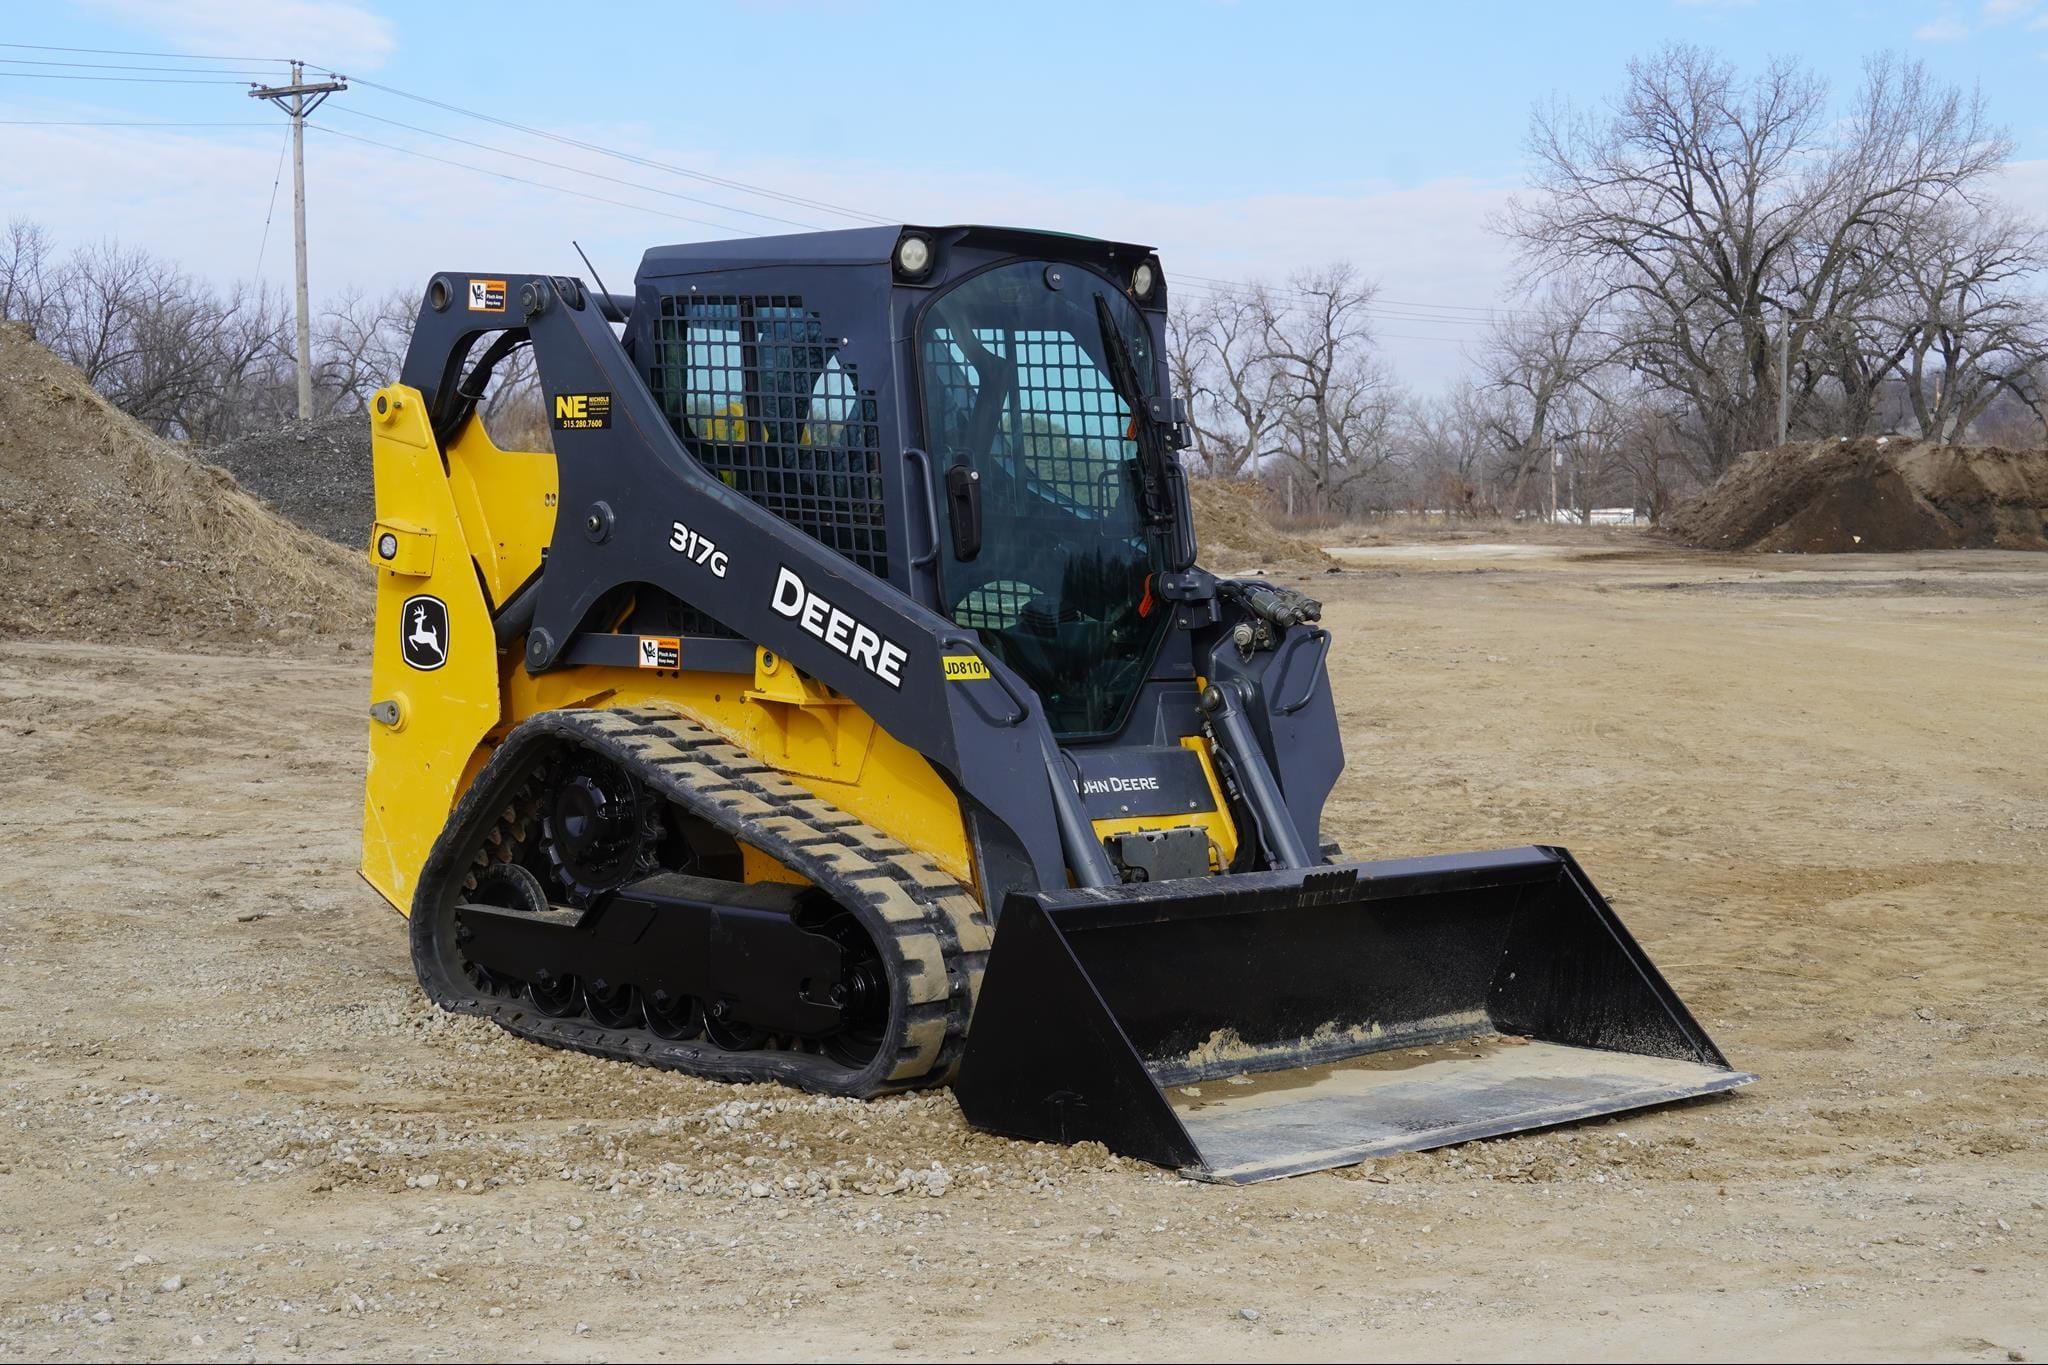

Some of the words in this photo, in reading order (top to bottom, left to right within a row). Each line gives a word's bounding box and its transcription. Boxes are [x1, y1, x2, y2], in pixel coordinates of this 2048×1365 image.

[556, 395, 588, 418] NE
[563, 420, 603, 428] 515.280.7600
[669, 522, 728, 578] 317G
[771, 566, 907, 687] DEERE
[1109, 777, 1159, 792] DEERE
